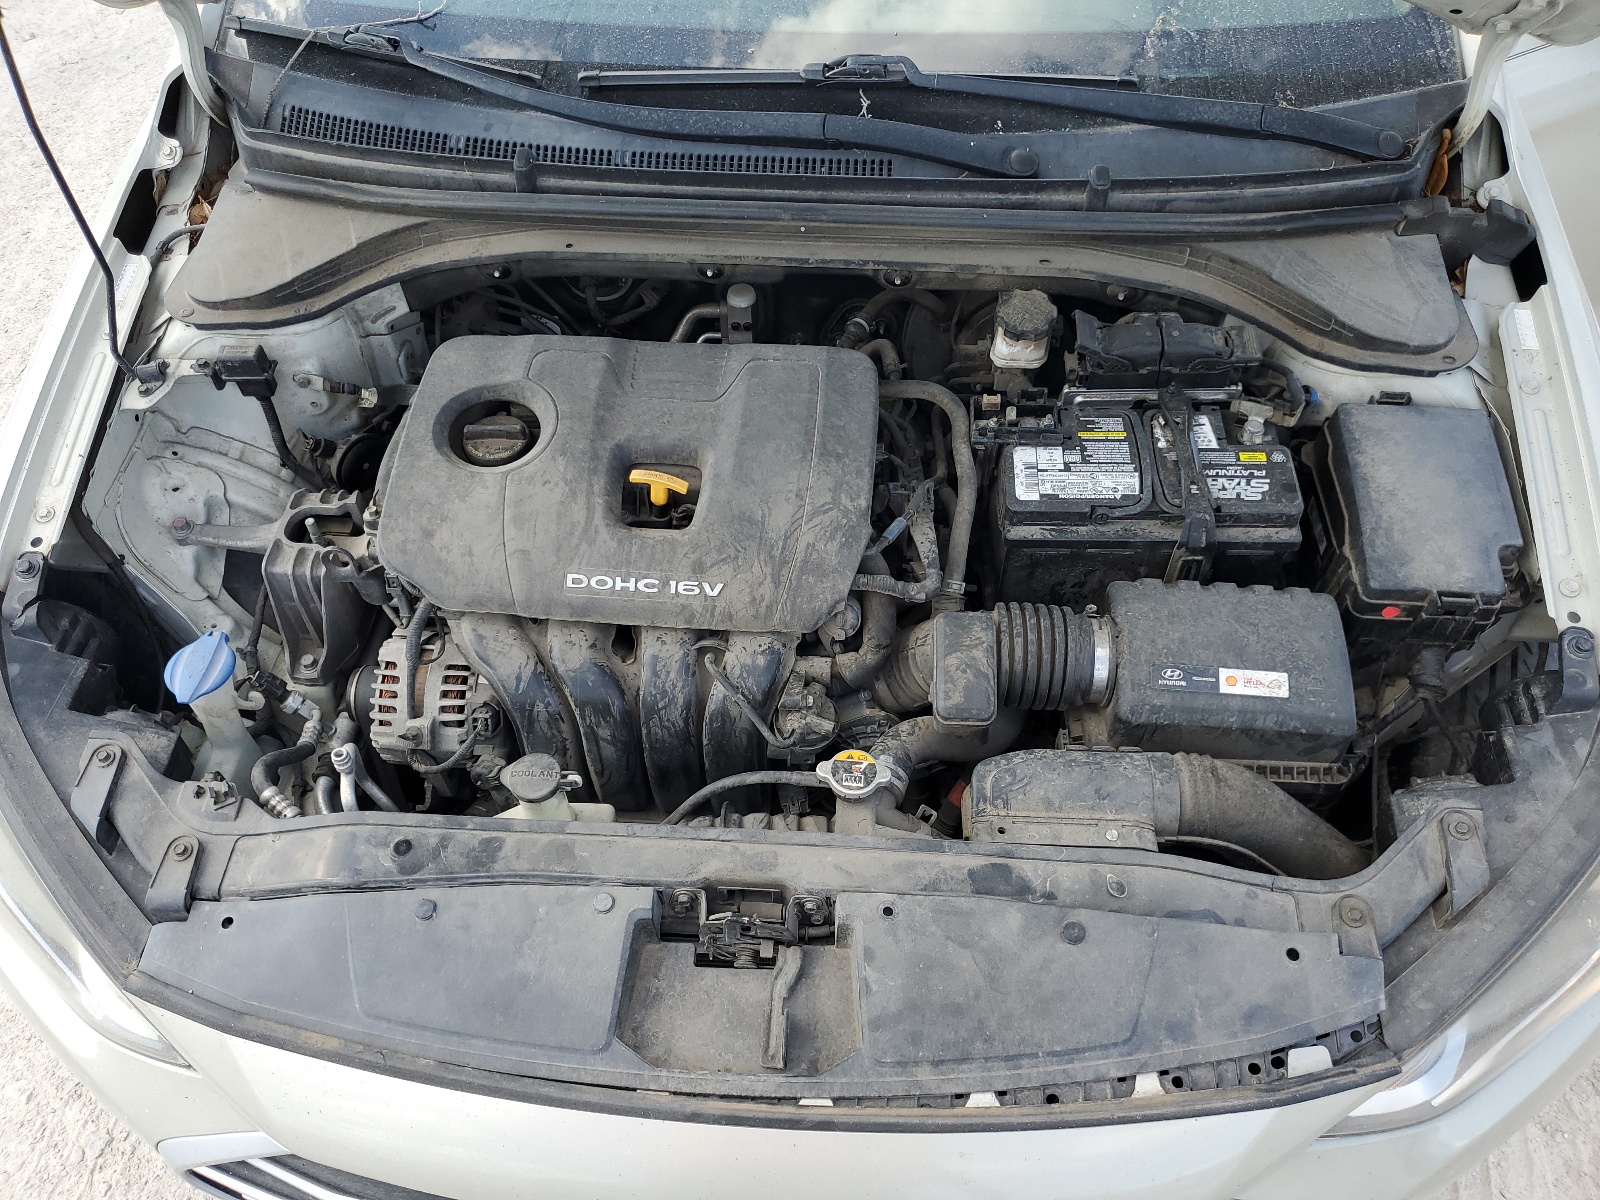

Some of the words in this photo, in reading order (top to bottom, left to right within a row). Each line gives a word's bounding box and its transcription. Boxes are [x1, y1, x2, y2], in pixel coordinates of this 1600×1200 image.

[566, 573, 660, 593] DOHC
[669, 580, 725, 597] 16V
[1158, 679, 1187, 687] HYUNDAI
[511, 770, 559, 778] COOLANT
